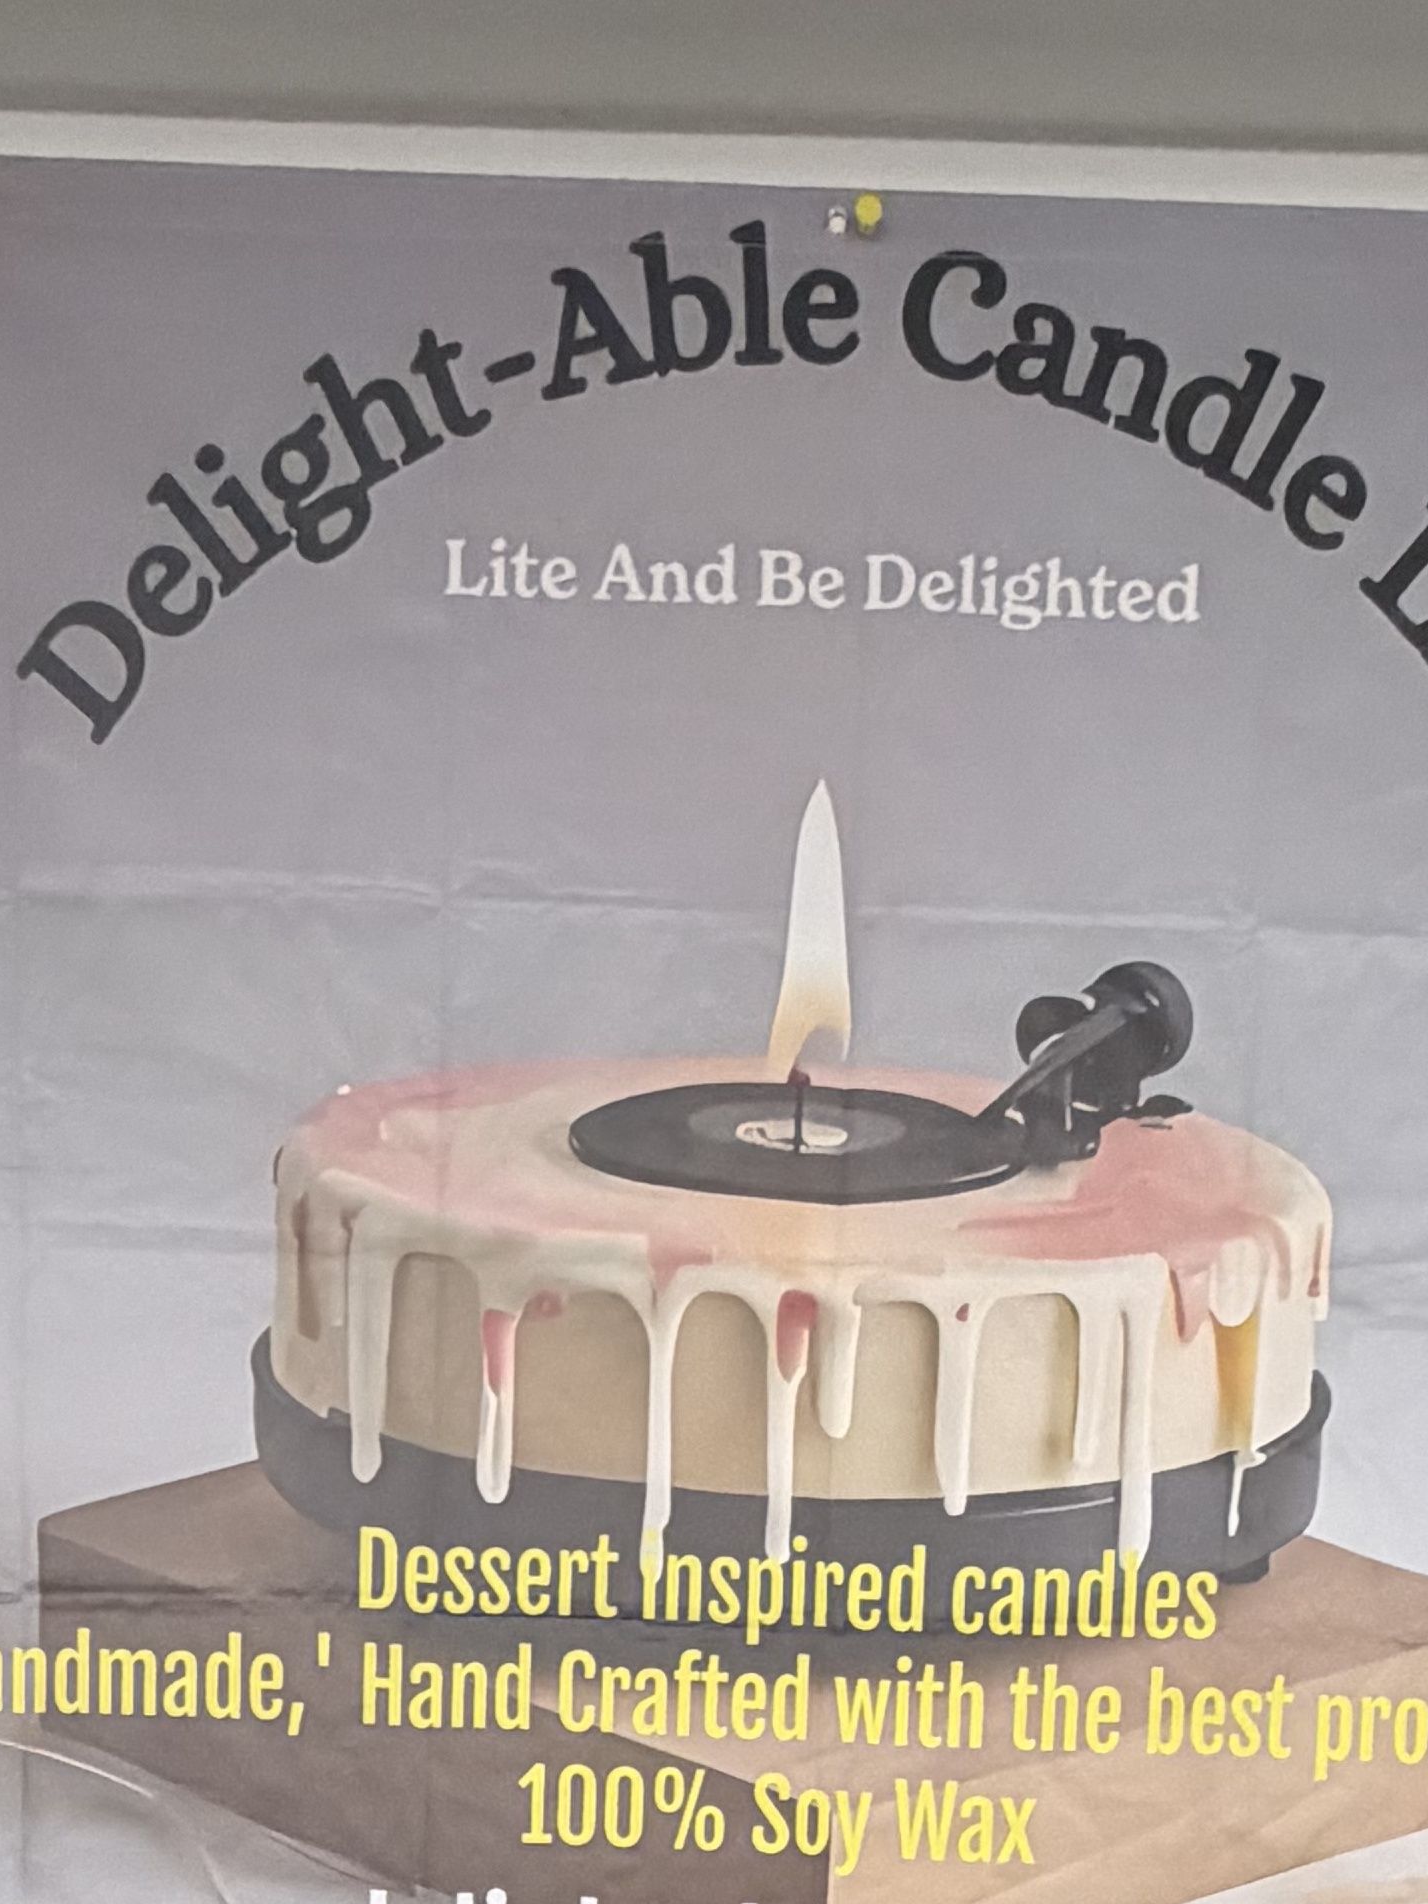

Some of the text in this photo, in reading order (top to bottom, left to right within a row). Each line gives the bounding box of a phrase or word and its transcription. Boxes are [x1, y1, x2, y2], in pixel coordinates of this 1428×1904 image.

[18, 220, 860, 745] Delight-Able
[899, 250, 1367, 547] Candle
[442, 535, 1200, 629] Lite And Be Delighted
[358, 1526, 1217, 1643] Dessert Inspired candles
[362, 1636, 528, 1734] Hand
[557, 1648, 810, 1746] Crafted
[831, 1653, 982, 1751] with
[1010, 1663, 1123, 1756] the
[1145, 1673, 1291, 1765] best
[518, 1760, 1037, 1876] 100% Soy Wax
